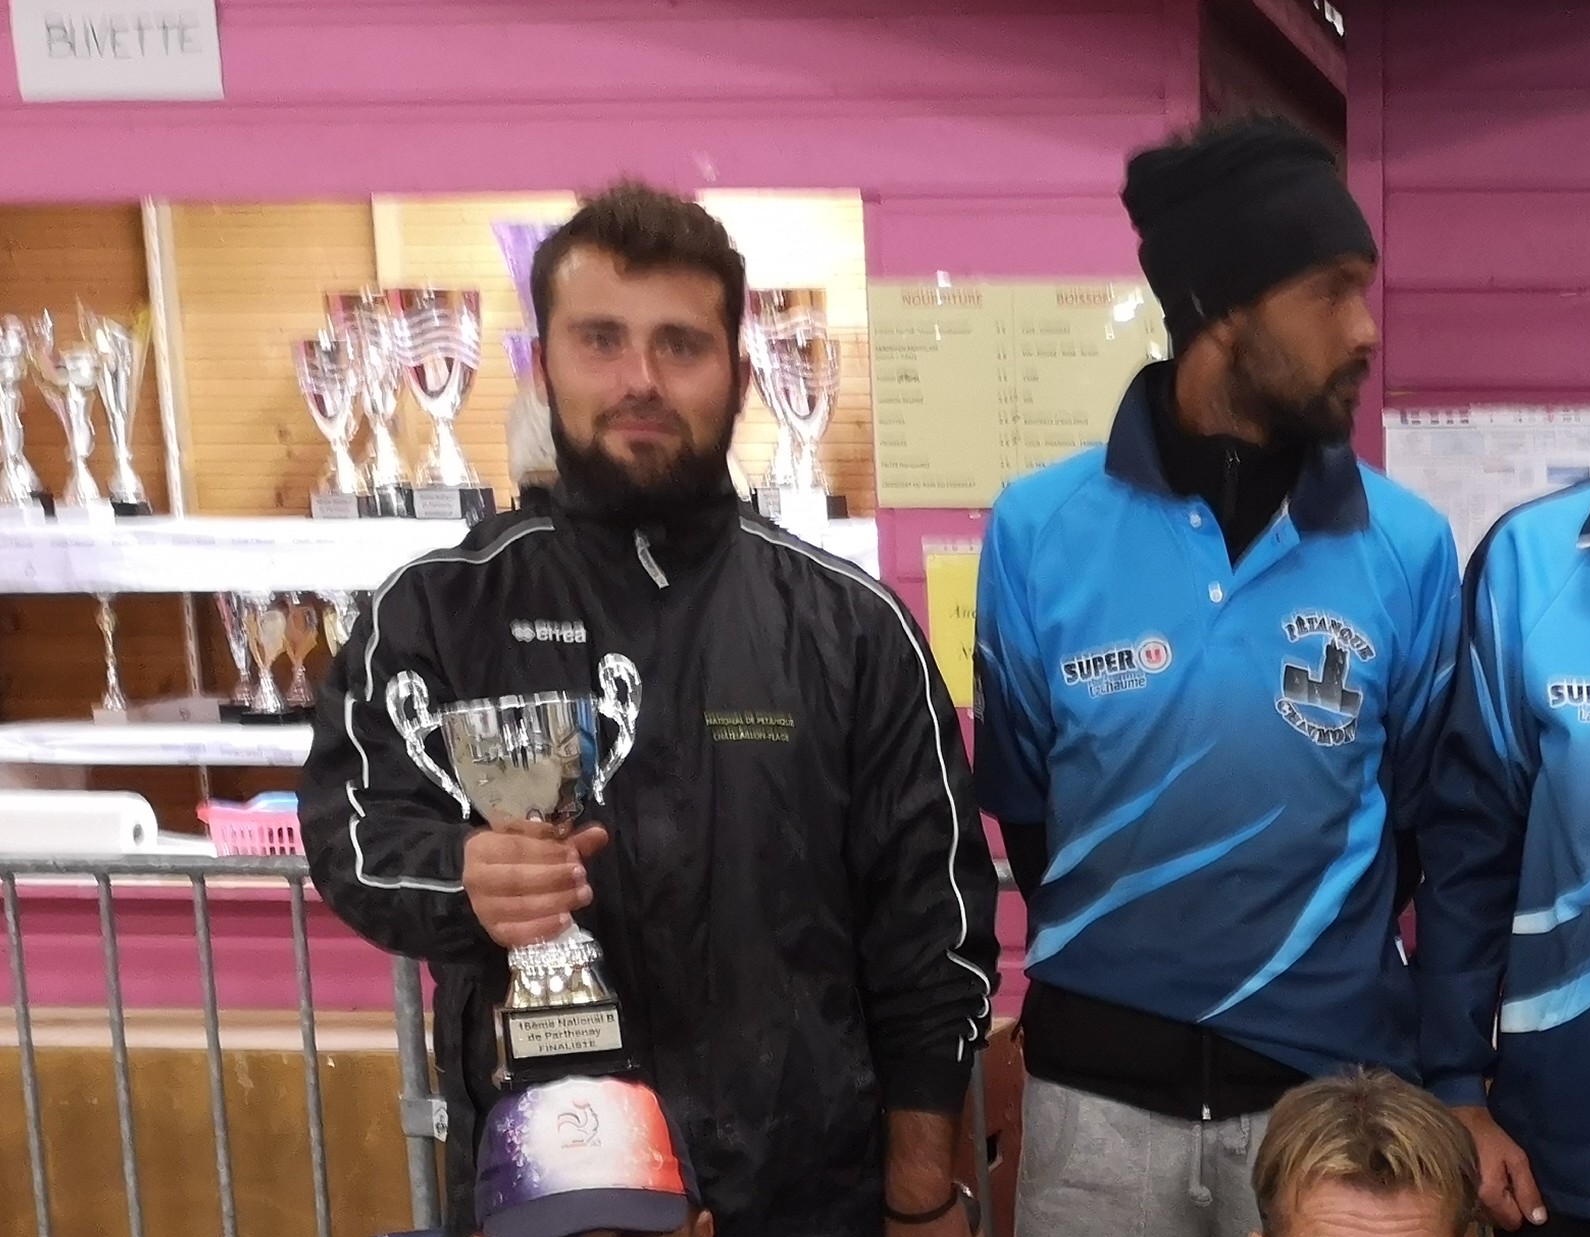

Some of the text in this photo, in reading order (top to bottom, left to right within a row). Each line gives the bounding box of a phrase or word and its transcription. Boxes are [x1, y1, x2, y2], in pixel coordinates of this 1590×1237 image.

[44, 14, 202, 59] BUVETTE
[1063, 648, 1136, 685] SUPER
[557, 1013, 604, 1027] National
[527, 1028, 602, 1042] de Parthenay
[538, 1040, 597, 1052] FINALISTE
